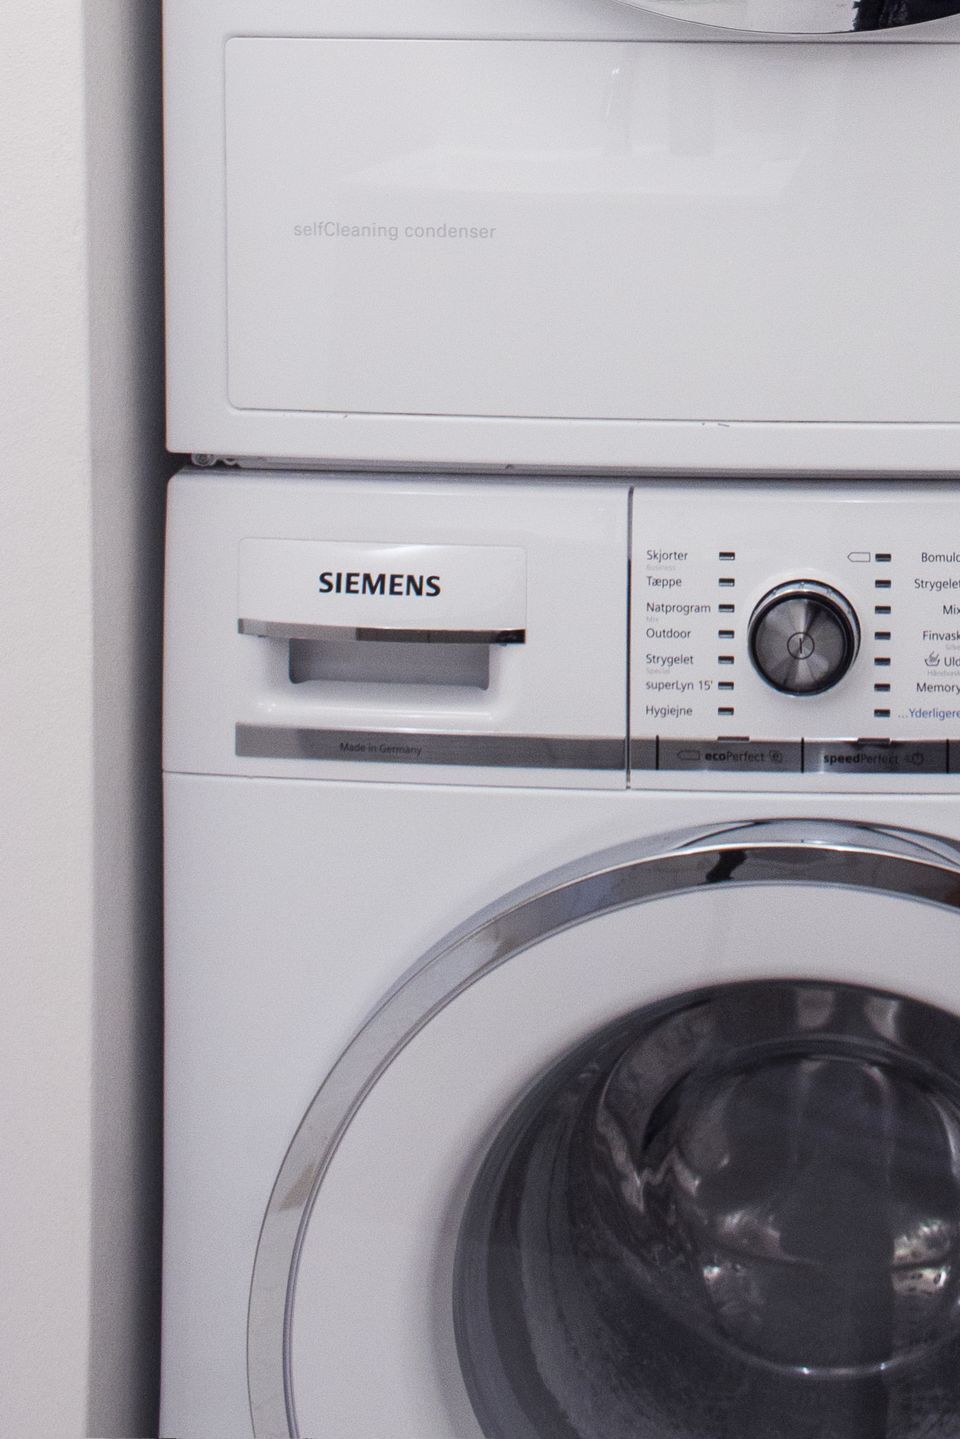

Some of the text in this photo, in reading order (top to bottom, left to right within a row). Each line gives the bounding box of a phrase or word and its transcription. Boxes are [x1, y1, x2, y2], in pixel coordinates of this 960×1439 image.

[293, 221, 496, 241] selfCleaning condenser
[646, 549, 688, 563] Skjorter
[318, 571, 441, 597] SIEMENS
[646, 576, 682, 588] Tæppe
[646, 602, 711, 615] Natprogram
[646, 628, 691, 639] Outdoor
[646, 654, 694, 666] Strygelet
[646, 680, 713, 692] superLyn 15'
[645, 705, 693, 718] Hygiejne
[339, 742, 422, 756] Made in Germany
[704, 751, 765, 762] ecoPerfect
[823, 753, 899, 765] speedPerfect
